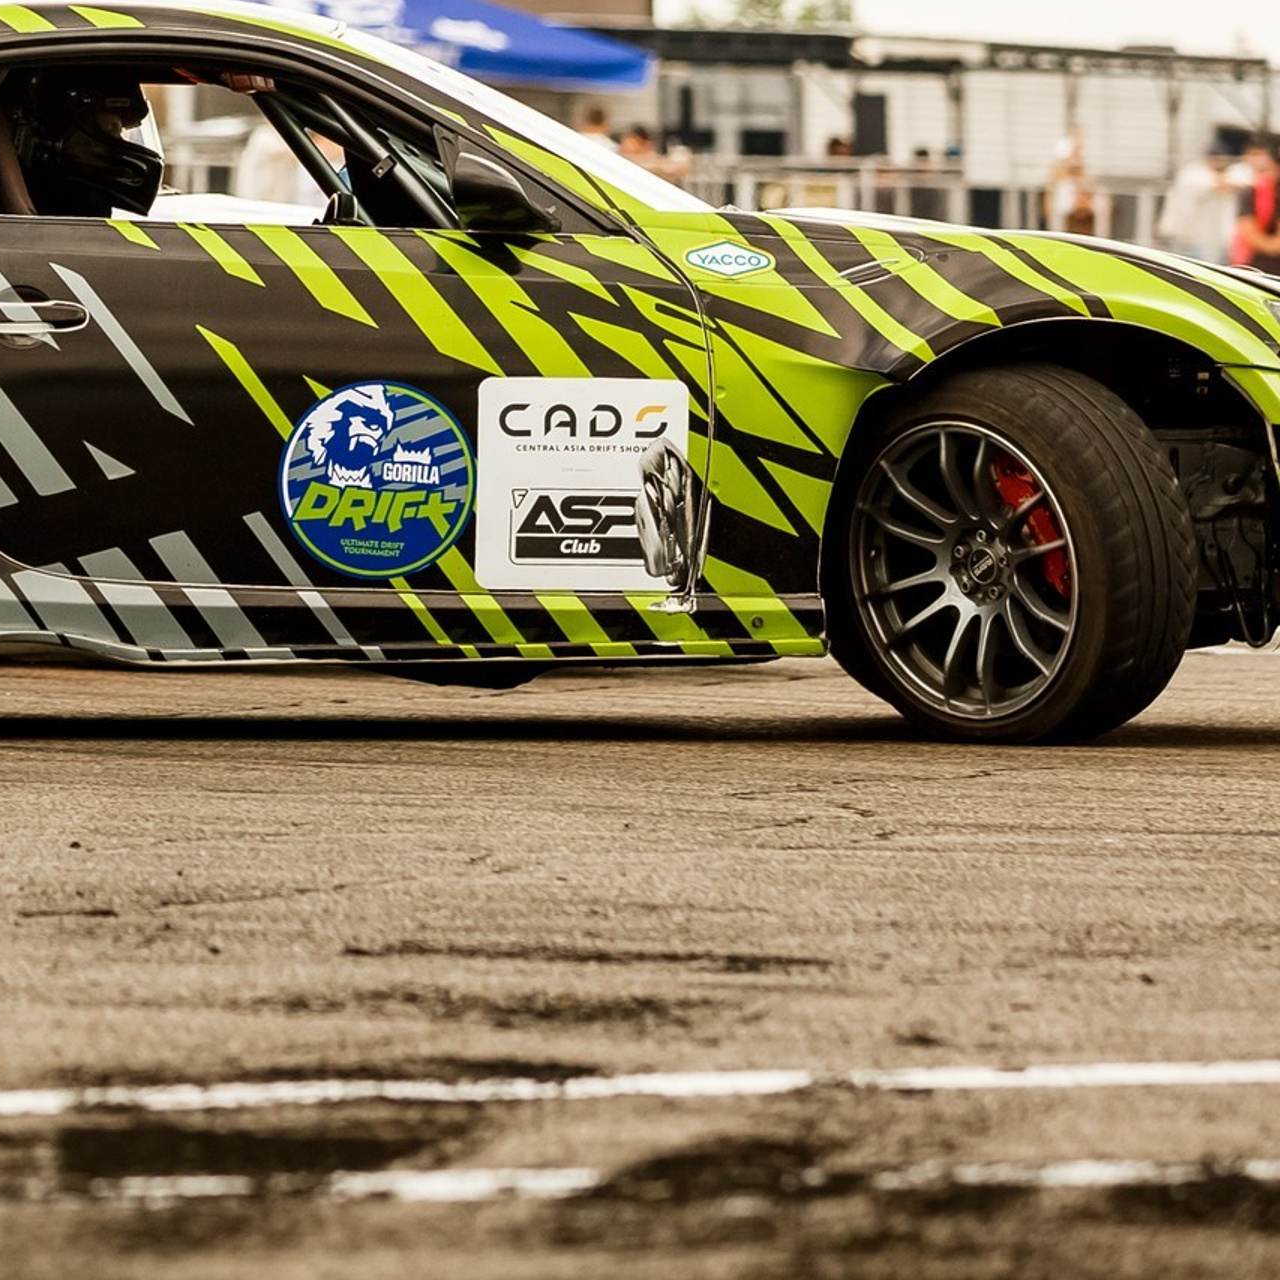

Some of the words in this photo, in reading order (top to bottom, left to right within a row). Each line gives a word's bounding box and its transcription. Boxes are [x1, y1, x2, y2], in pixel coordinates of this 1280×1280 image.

[696, 253, 761, 267] YACCO
[499, 403, 669, 439] CADS
[515, 444, 561, 453] CENTRAL
[563, 444, 586, 453] ASIA
[588, 444, 617, 453] DRIFT
[382, 462, 441, 485] GORILLA
[292, 481, 458, 539] DRIFT
[340, 538, 379, 548] ULTIMATE
[381, 541, 405, 550] DRIFT
[343, 546, 401, 557] TOURNAMENT
[559, 538, 601, 555] Club
